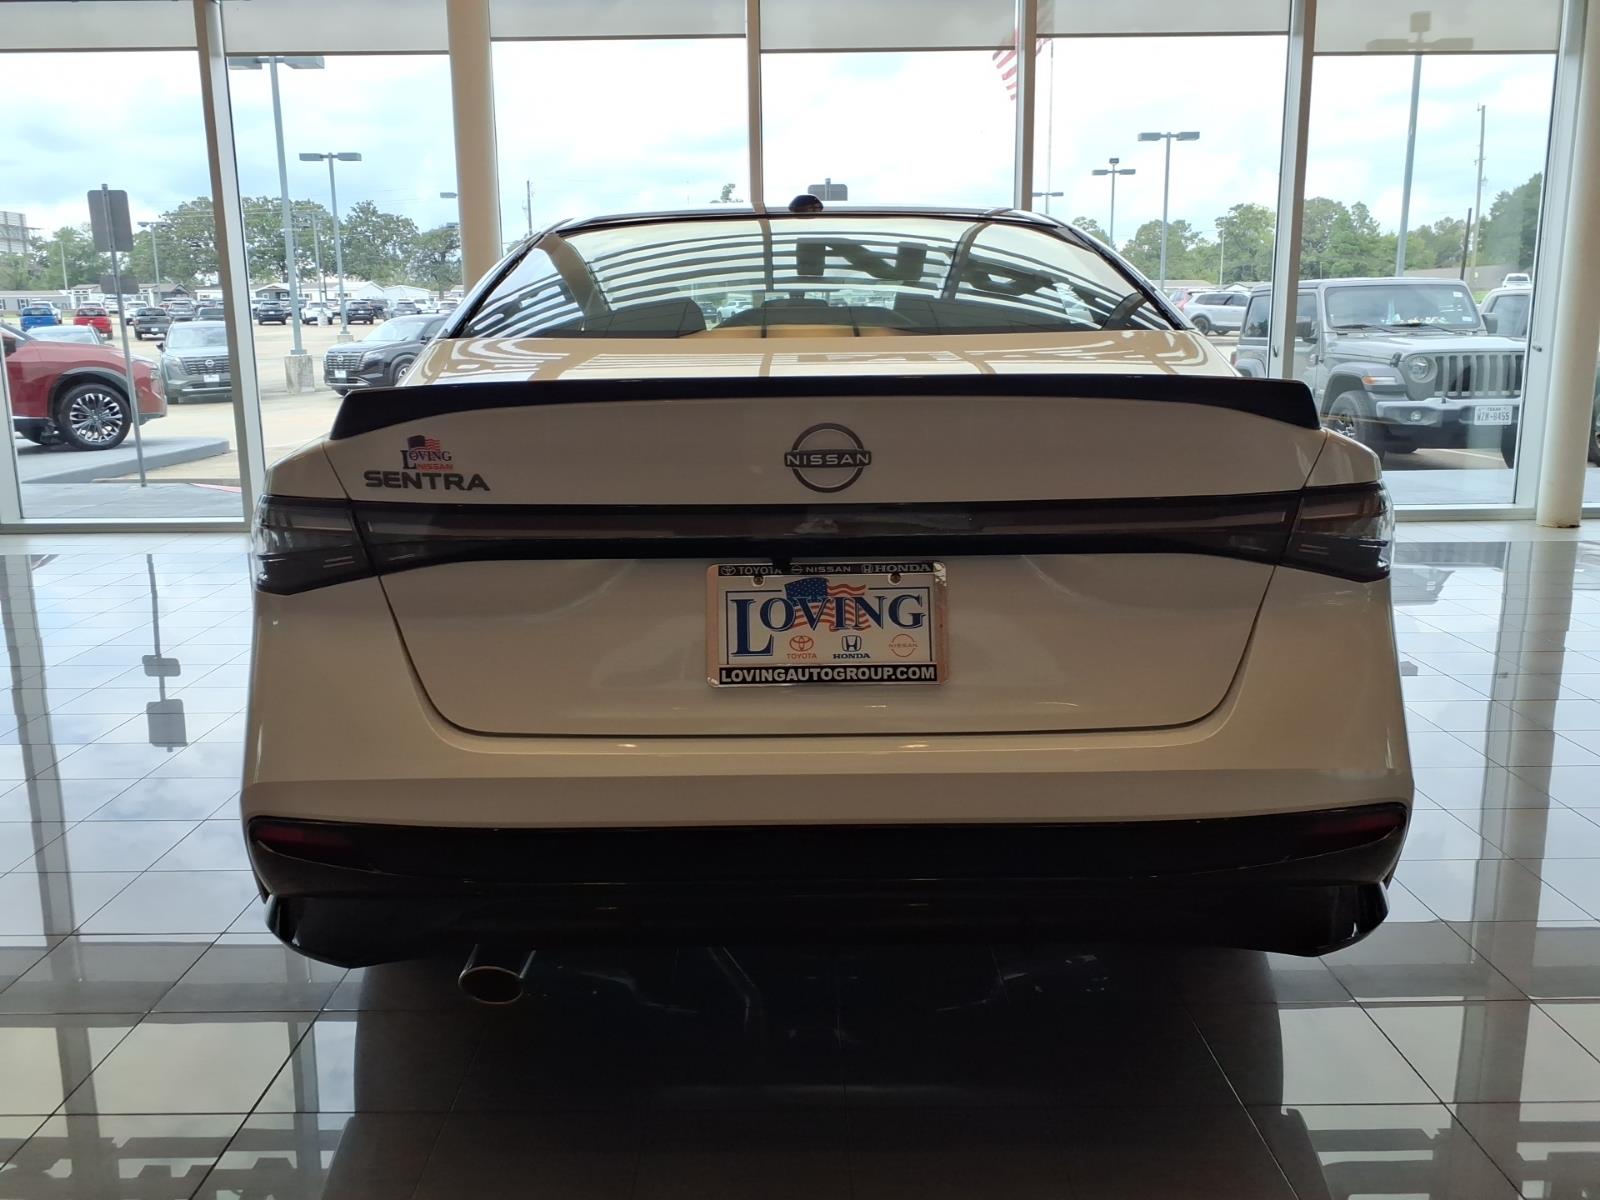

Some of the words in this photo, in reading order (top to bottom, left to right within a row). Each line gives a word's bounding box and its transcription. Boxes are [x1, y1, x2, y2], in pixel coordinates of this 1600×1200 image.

[786, 454, 870, 465] NISSAN
[417, 463, 453, 471] NISSAN
[363, 470, 491, 491] SENTRA
[874, 564, 931, 573] HONDA
[730, 594, 926, 657] LOVING
[721, 667, 935, 683] LOVINGAUTOGROUP.COM
